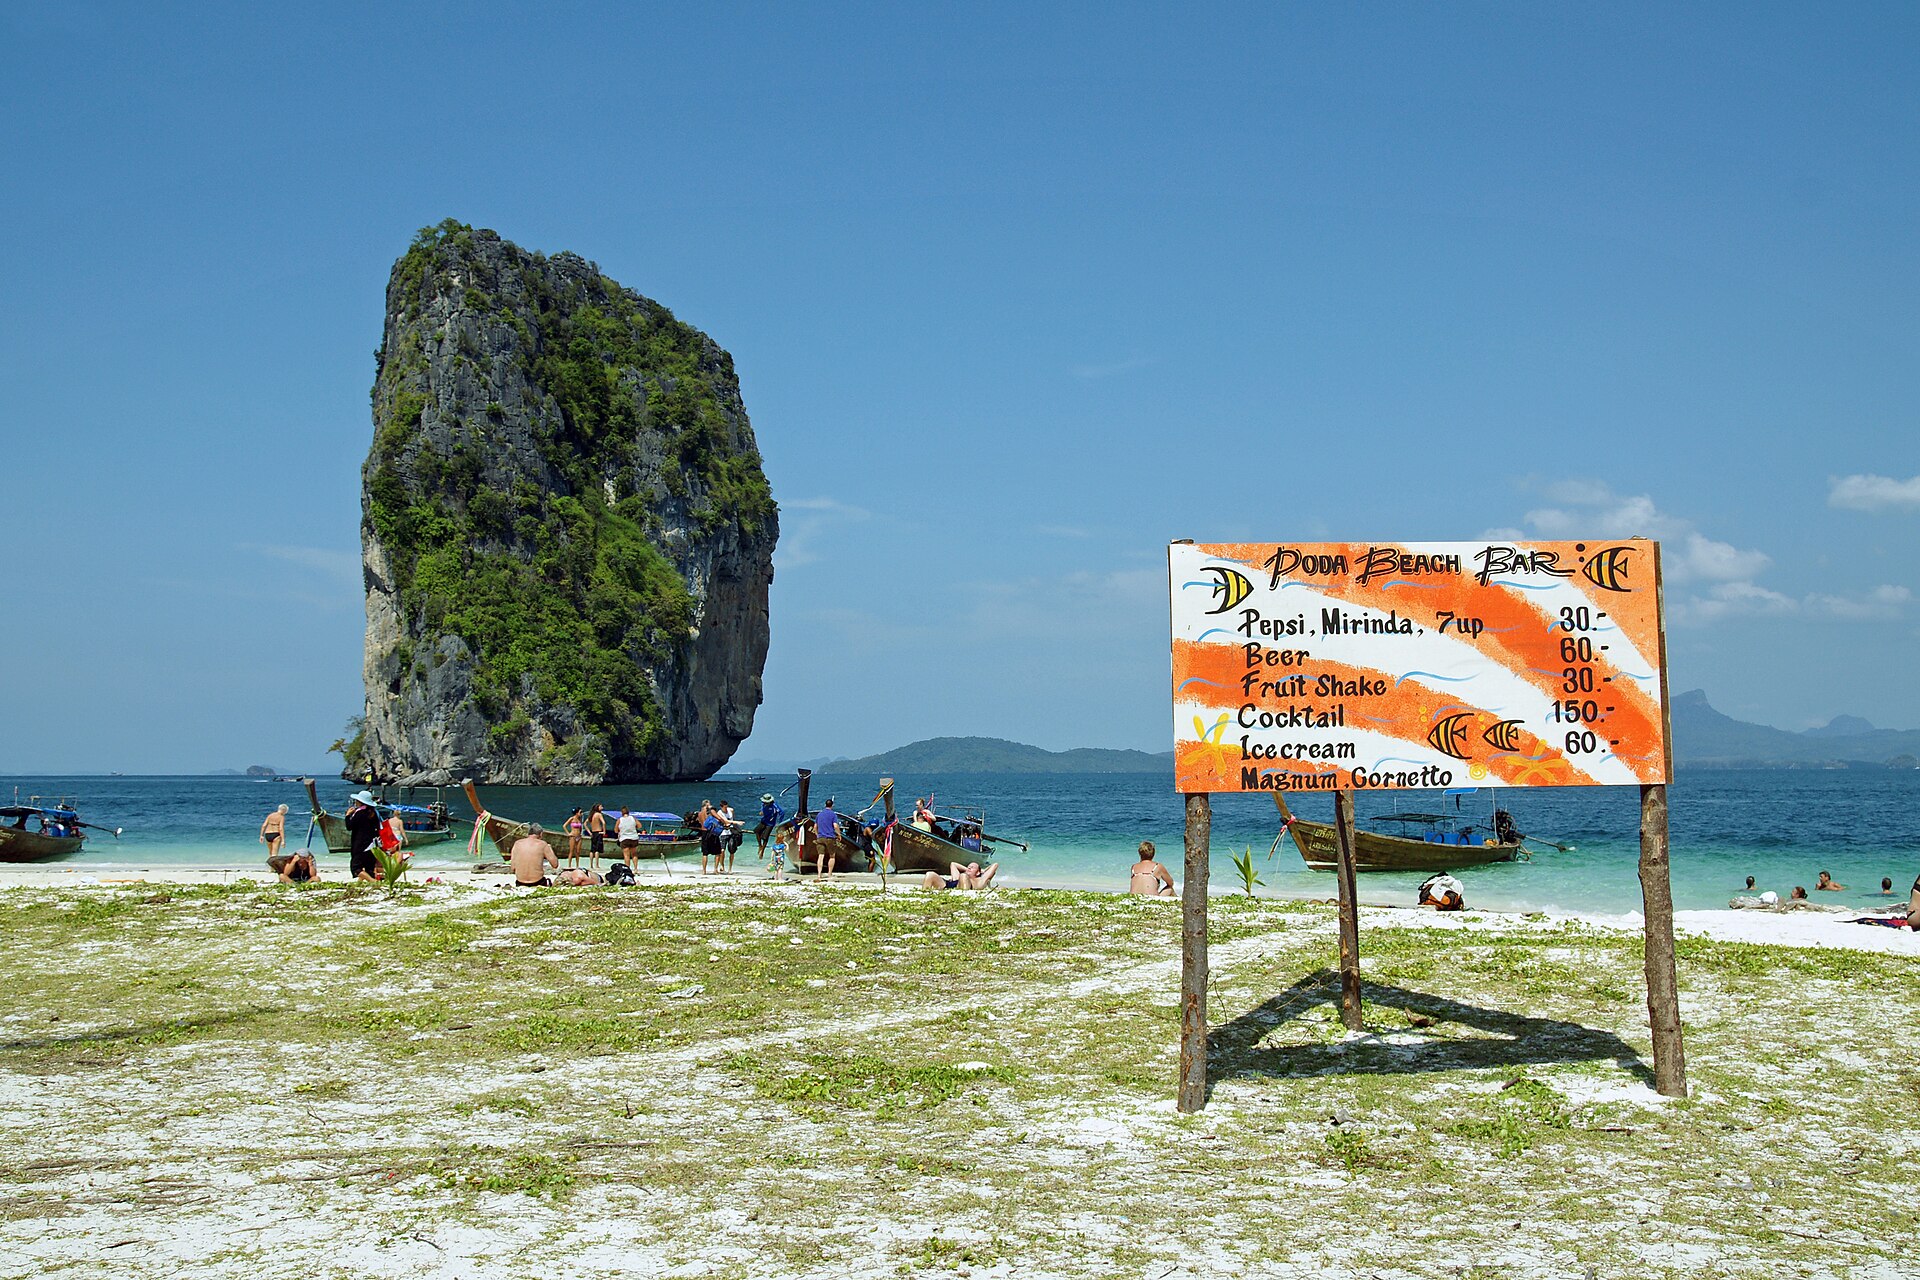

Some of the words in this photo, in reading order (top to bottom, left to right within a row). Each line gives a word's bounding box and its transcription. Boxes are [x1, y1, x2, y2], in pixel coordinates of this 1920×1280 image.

[1264, 546, 1349, 591] PODA
[1355, 547, 1461, 587] BEACH
[1474, 545, 1576, 587] BAR
[1237, 608, 1316, 641] Pepsi,
[1321, 607, 1424, 638] Mirinda,
[1436, 610, 1484, 639] 7up
[1241, 642, 1310, 669] Beer
[1240, 669, 1308, 698] Fruit
[1314, 673, 1387, 697] Shake
[1237, 703, 1345, 729] Cocktail
[1241, 766, 1338, 791] Magnum
